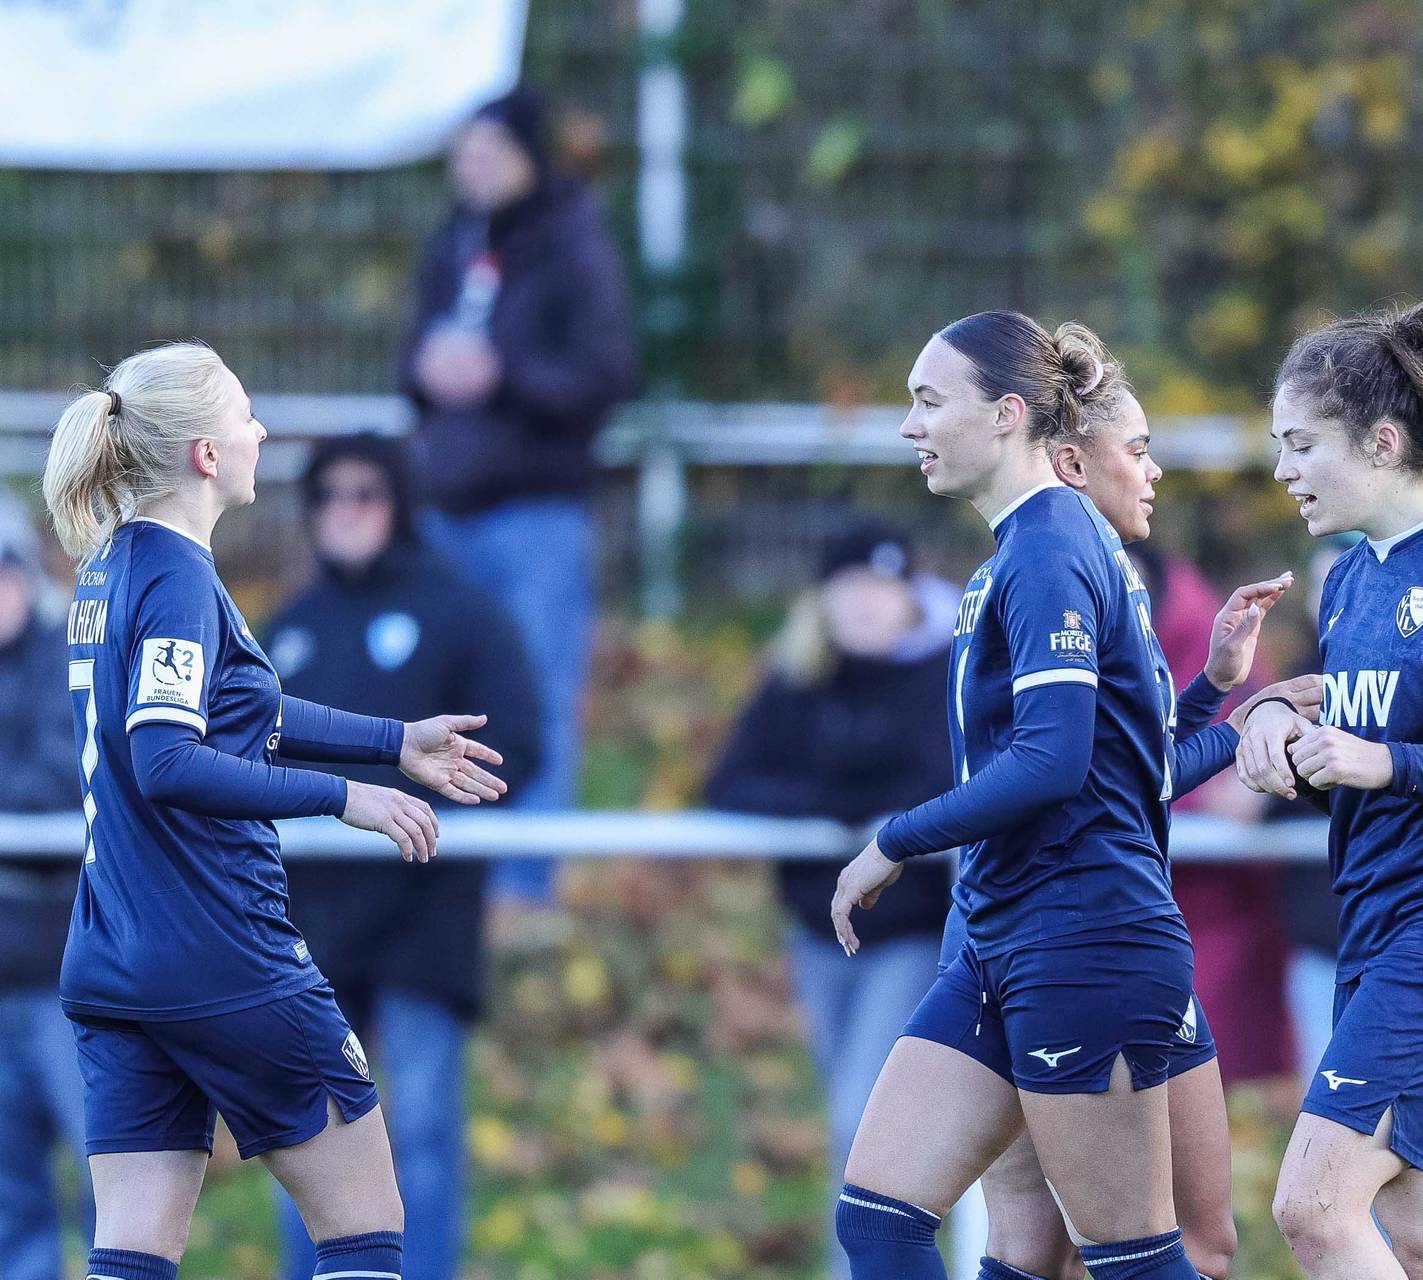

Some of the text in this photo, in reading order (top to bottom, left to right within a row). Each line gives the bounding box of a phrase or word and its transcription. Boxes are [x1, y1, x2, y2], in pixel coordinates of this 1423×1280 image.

[1049, 632, 1092, 653] FIEGE
[180, 649, 194, 668] 2
[146, 695, 190, 705] BUNDESLIGA
